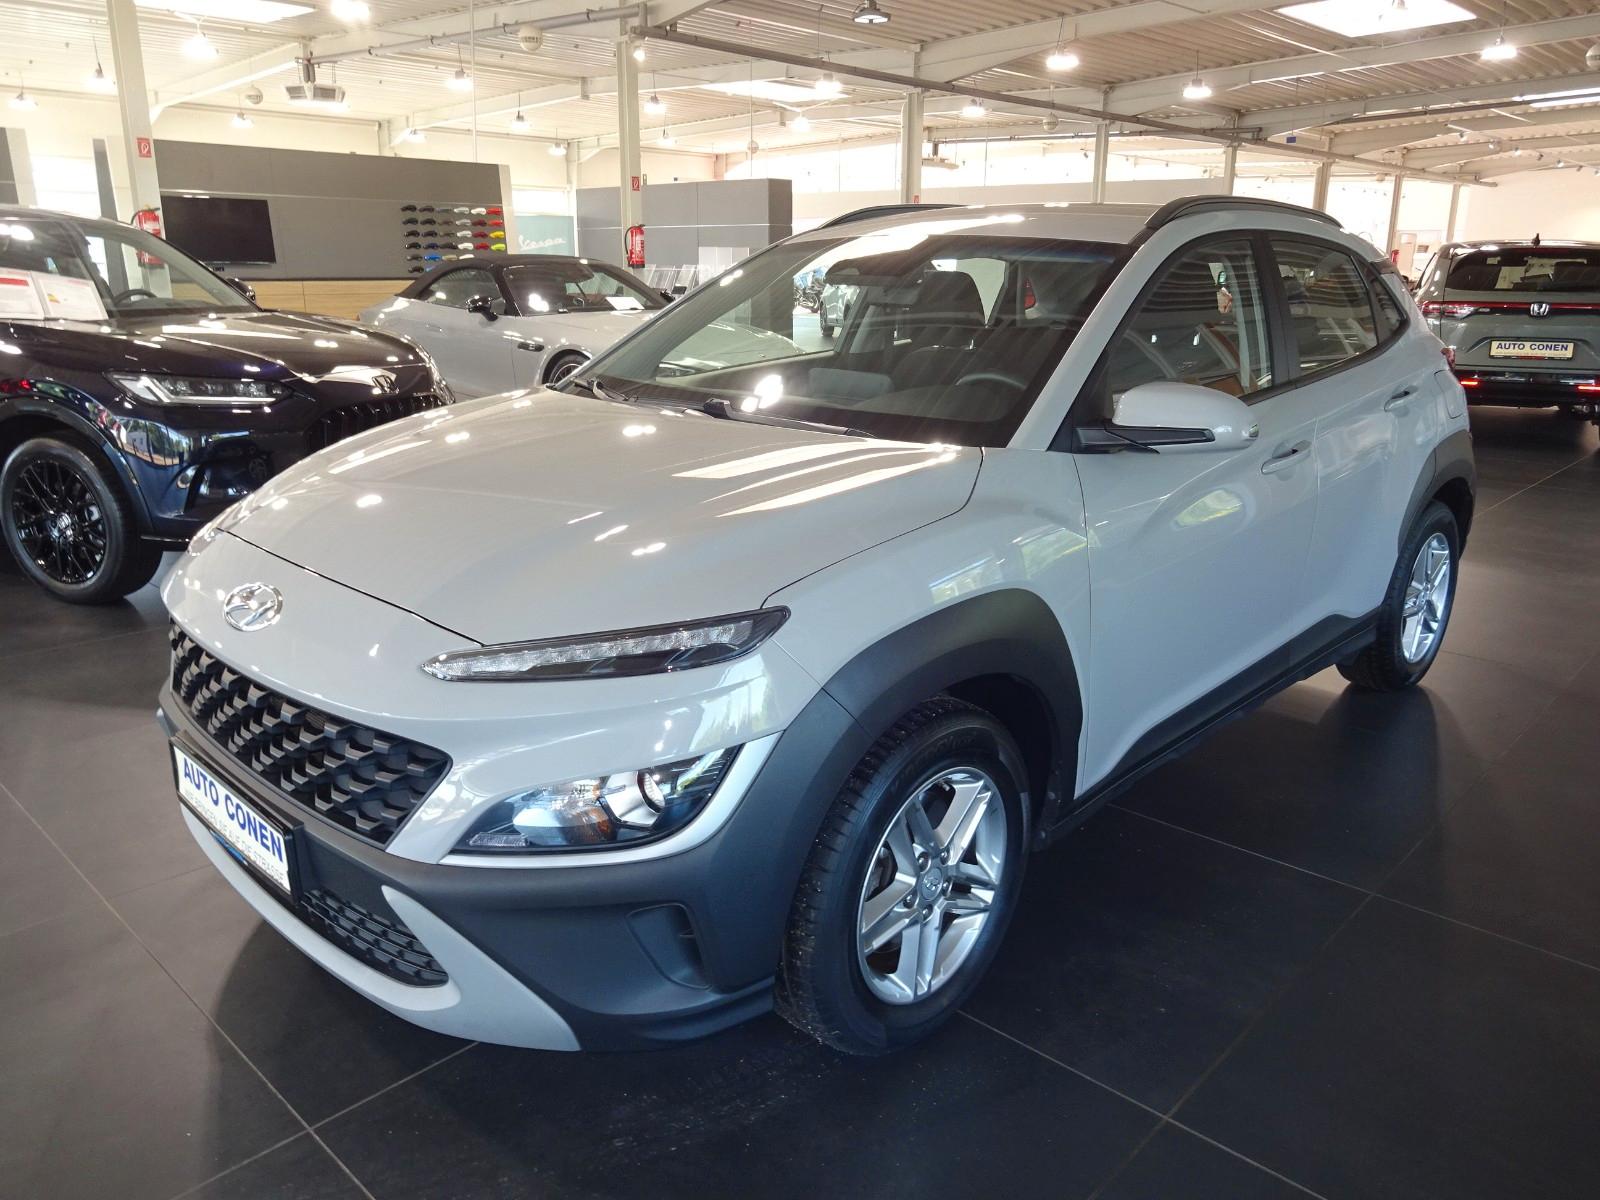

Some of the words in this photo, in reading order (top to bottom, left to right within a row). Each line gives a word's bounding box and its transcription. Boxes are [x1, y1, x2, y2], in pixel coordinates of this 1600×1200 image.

[518, 234, 567, 251] Vespa
[184, 757, 219, 807] AUTO
[224, 793, 283, 863] CONEN
